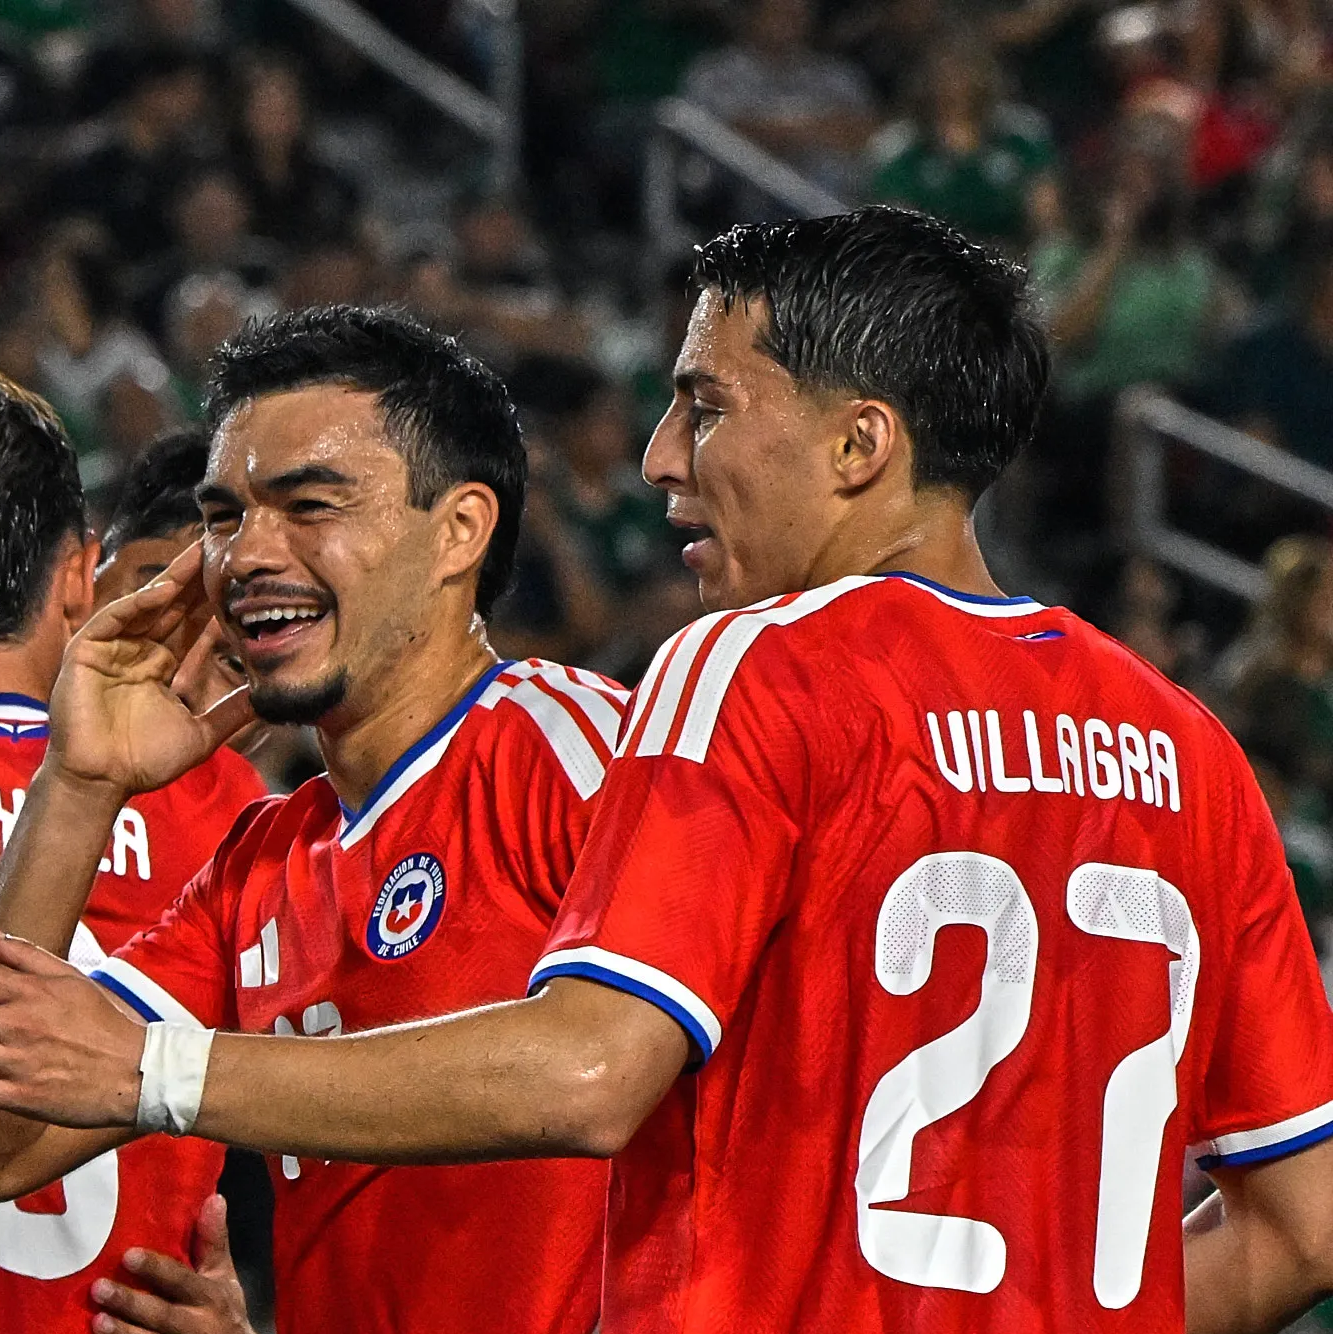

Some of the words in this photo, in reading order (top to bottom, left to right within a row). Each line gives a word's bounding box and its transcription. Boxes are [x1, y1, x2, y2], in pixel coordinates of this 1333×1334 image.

[926, 709, 1181, 813] VILLAGRA
[372, 857, 414, 918] FEDERACION
[418, 856, 431, 869] DE
[429, 862, 444, 900] FUTBOL
[377, 944, 392, 957] DE
[393, 934, 419, 957] CHILE
[854, 851, 1201, 1310] 27
